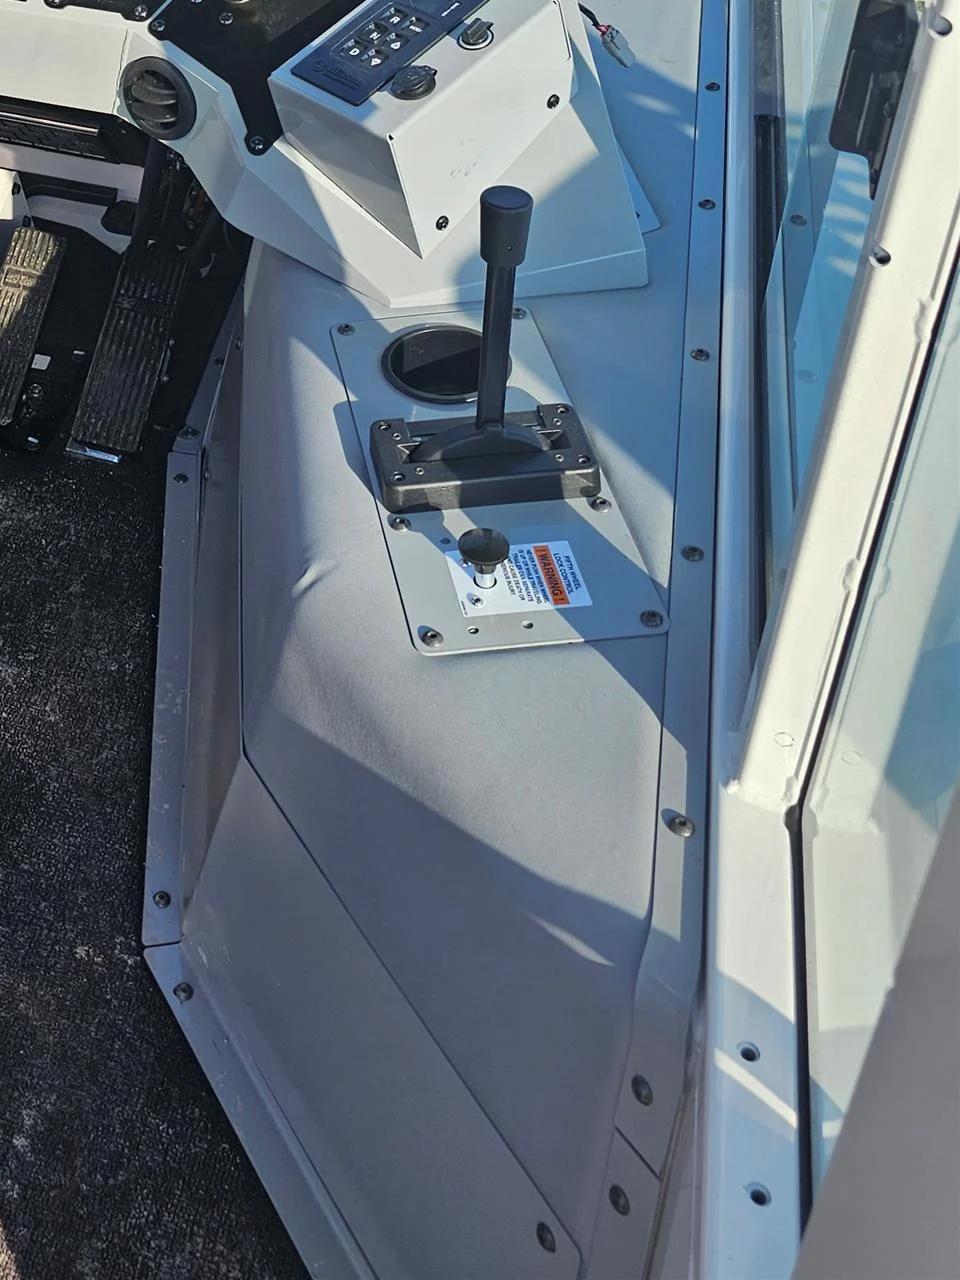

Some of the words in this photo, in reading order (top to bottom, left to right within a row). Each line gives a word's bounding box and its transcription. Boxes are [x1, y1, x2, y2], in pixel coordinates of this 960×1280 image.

[389, 16, 401, 24] R
[369, 32, 381, 40] N
[349, 47, 360, 56] D
[539, 554, 563, 596] WARNING
[553, 553, 563, 568] LOCK
[559, 568, 574, 593] CONTROL
[564, 555, 575, 571] FIFTH
[570, 571, 582, 590] WHEEL
